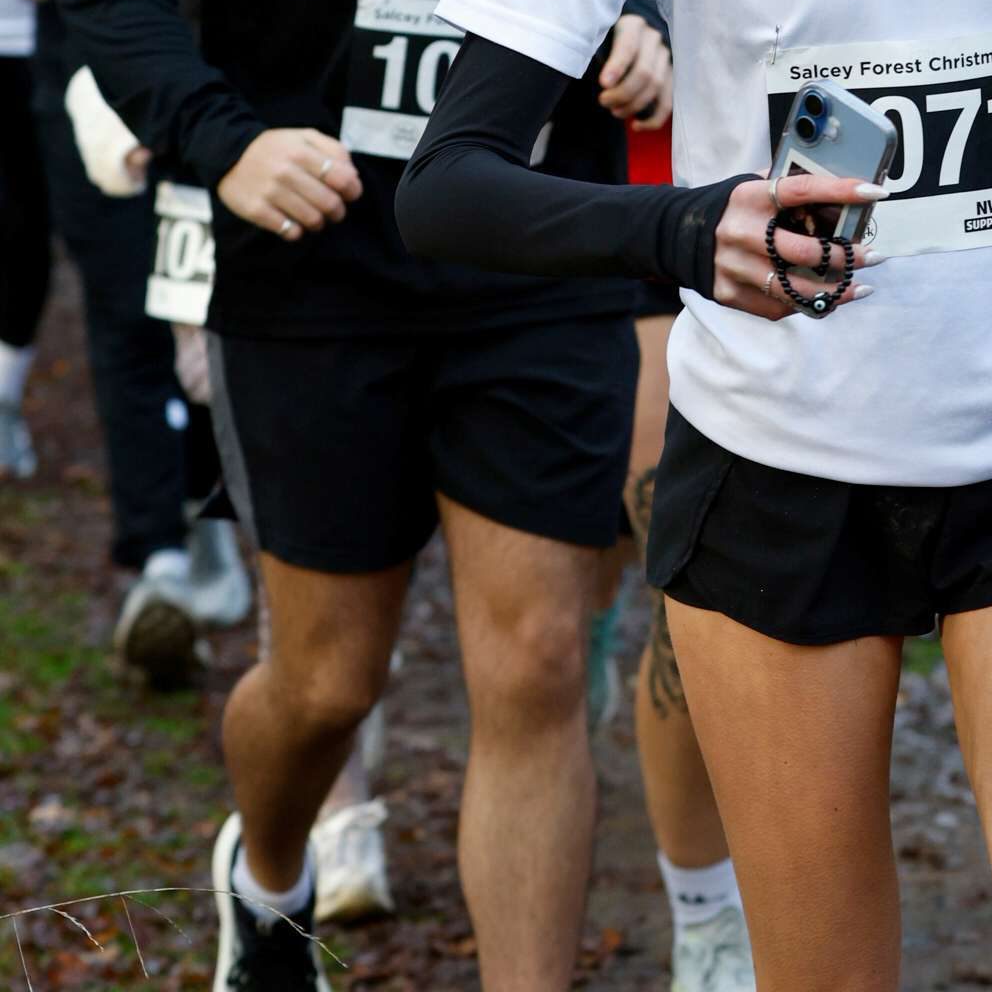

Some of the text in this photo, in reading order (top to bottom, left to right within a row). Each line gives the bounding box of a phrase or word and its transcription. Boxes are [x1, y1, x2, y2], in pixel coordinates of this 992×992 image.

[373, 9, 420, 24] Salcey
[790, 64, 853, 80] Salcey
[860, 59, 922, 76] Forest
